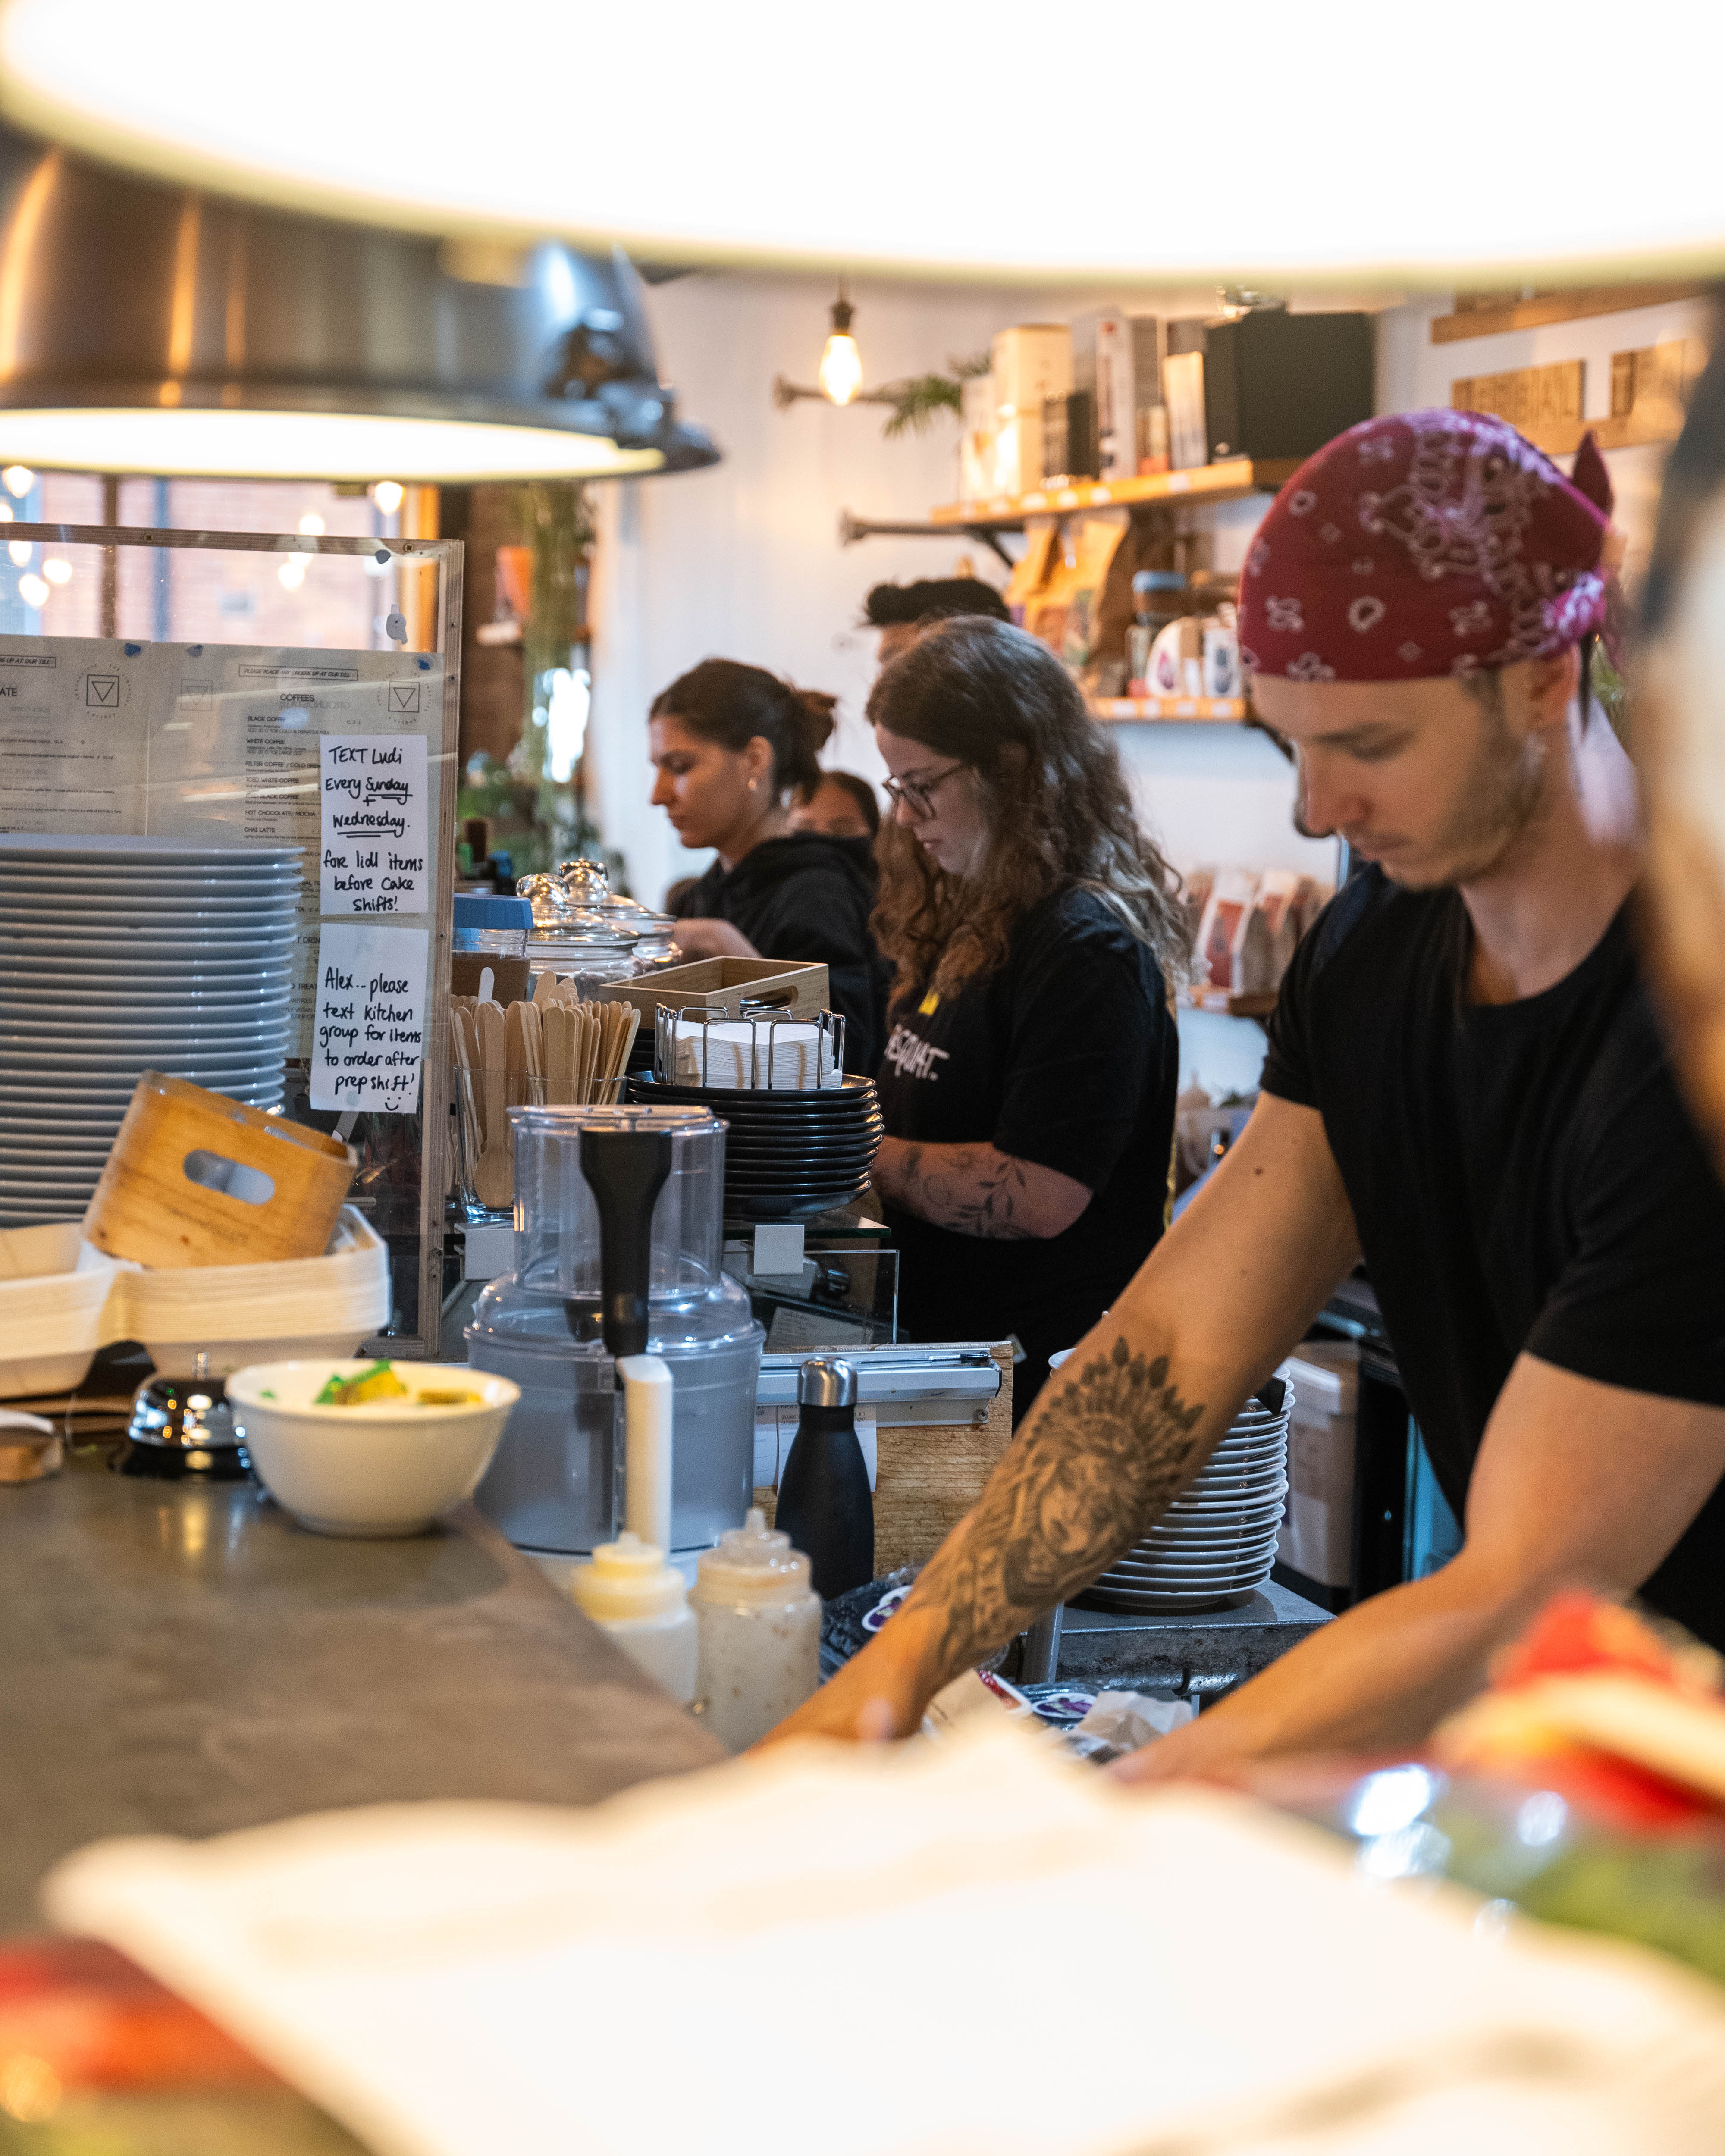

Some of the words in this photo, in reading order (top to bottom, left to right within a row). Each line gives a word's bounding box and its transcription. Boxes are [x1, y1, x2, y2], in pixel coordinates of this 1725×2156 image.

[280, 693, 315, 702] COFFEES
[329, 745, 368, 764] TEXT
[372, 747, 402, 764] Ludi
[325, 777, 361, 799] Every
[365, 777, 409, 805] Sunday
[388, 852, 423, 871] items
[334, 874, 373, 891] before
[370, 972, 408, 1002] please
[323, 1002, 354, 1020] text
[319, 1025, 358, 1048] group
[364, 1024, 386, 1041] for
[389, 1028, 421, 1043] items
[324, 1048, 339, 1067] to
[343, 1051, 383, 1067] order
[385, 1051, 420, 1066] after
[335, 1075, 367, 1095] prep
